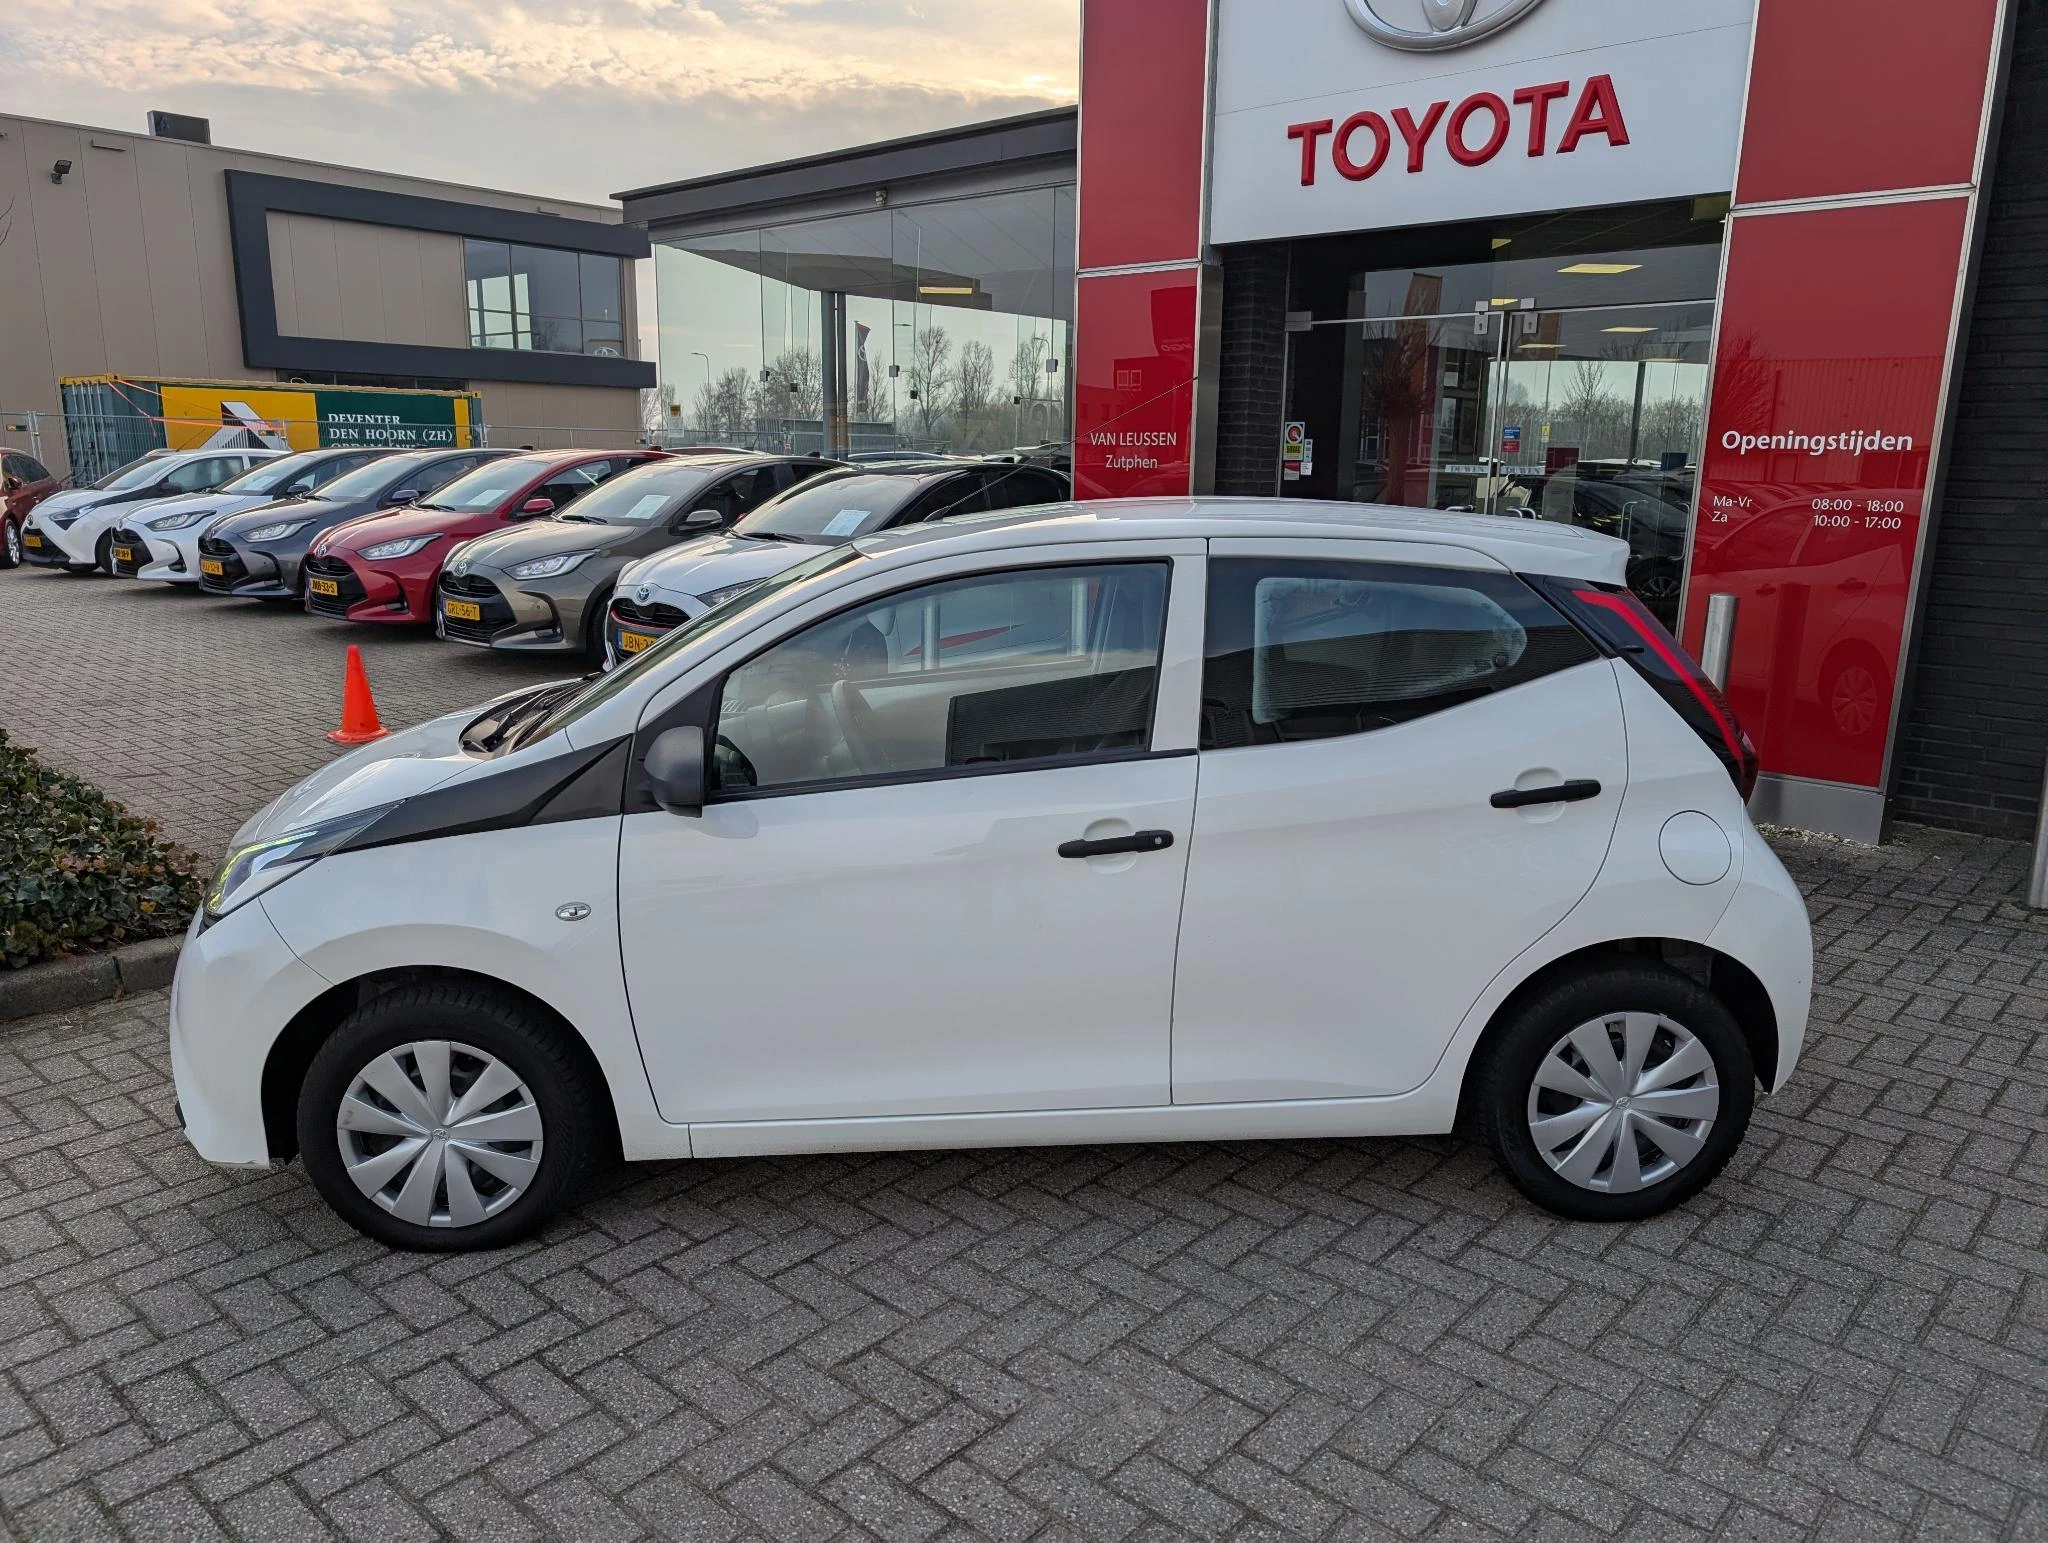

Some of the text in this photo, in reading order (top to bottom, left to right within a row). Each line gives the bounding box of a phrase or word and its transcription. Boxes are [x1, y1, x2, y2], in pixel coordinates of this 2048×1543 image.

[1287, 74, 1631, 187] TOYOTA
[327, 413, 400, 425] DEVENTER
[329, 428, 453, 442] DEN HOORN (ZH)
[1090, 432, 1177, 446] VAN LEUSSEN
[1722, 430, 1913, 457] Openingstijden
[1105, 454, 1158, 472] Zutphen
[1713, 496, 1752, 508] Ma-Vr
[1811, 498, 1853, 511] 08:00
[1867, 500, 1904, 513] 18:00
[1711, 511, 1728, 522] Za
[1814, 515, 1850, 528] 10:00
[1864, 517, 1902, 530] 17:00
